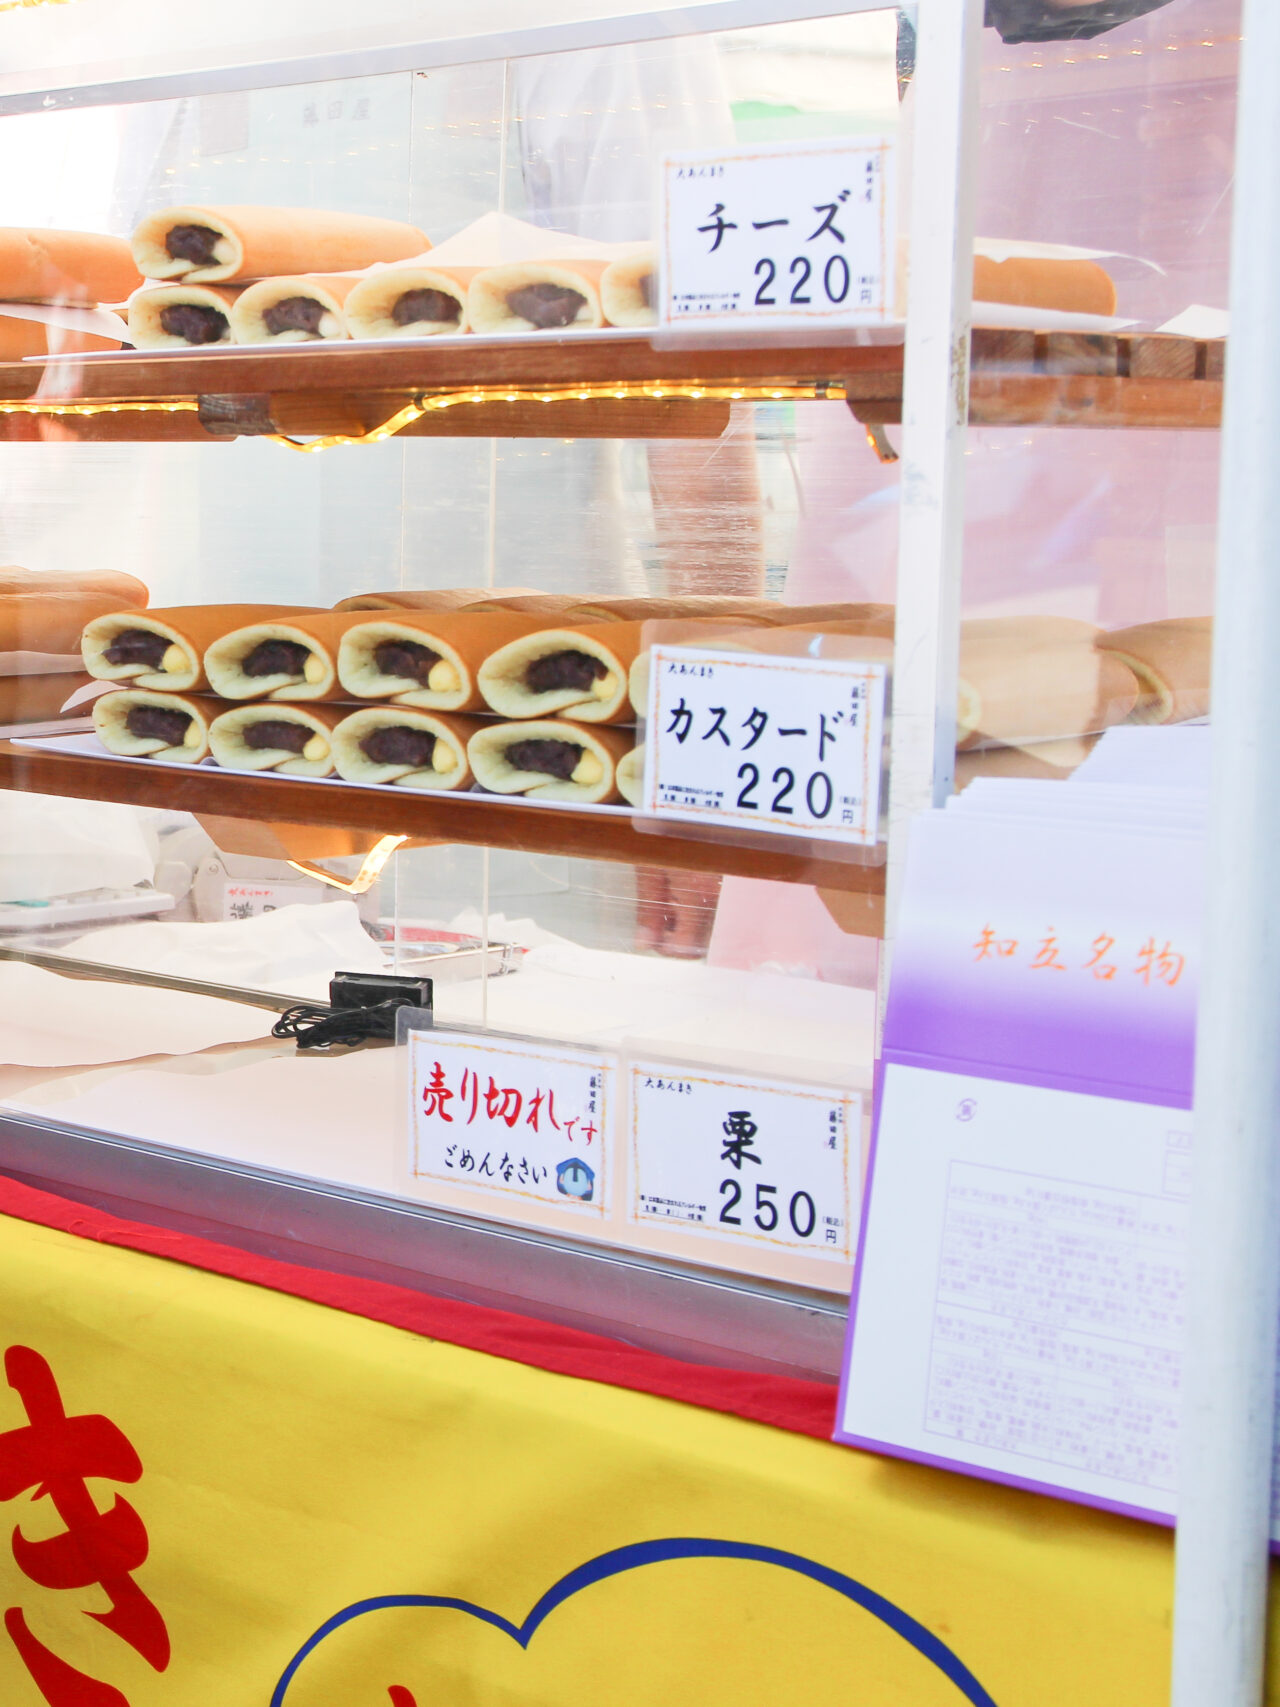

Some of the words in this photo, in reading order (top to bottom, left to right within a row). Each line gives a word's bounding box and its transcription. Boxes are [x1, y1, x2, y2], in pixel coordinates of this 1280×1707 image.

[696, 189, 852, 255] チーズ
[754, 254, 851, 306] 220
[665, 697, 845, 762] カスタード
[736, 762, 834, 820] 220
[842, 809, 854, 825] 円
[972, 922, 1187, 988] 知立名物
[422, 1061, 598, 1146] 売り切れです
[644, 1076, 694, 1095] 大あんまき
[444, 1144, 548, 1185] ごめんなさい
[720, 1110, 763, 1171] 栗
[719, 1178, 817, 1238] 250
[825, 1229, 837, 1244] 円
